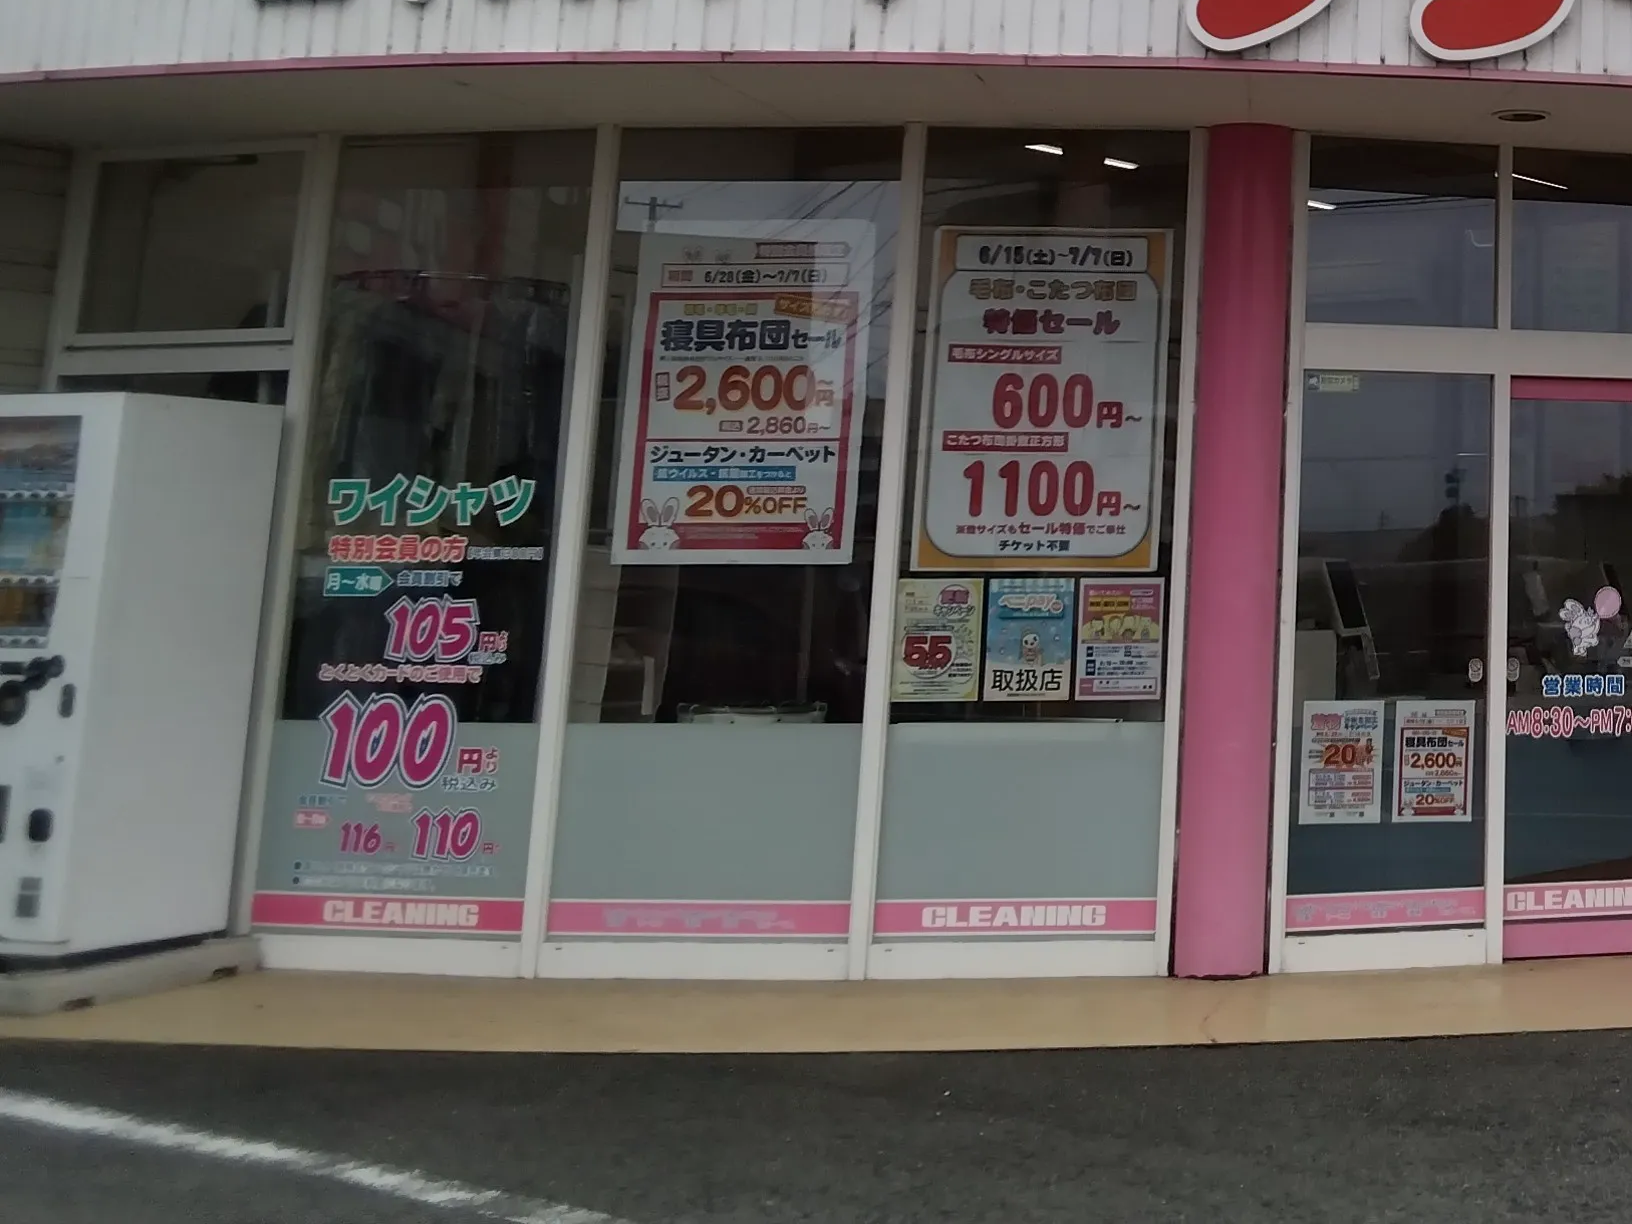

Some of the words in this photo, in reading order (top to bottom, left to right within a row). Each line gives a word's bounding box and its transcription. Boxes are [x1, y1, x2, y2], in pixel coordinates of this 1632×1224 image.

[660, 319, 842, 351] 寝具布団セール
[950, 347, 1059, 362] 毛布シングルサイズ
[328, 473, 536, 526] ワイシャツ
[684, 484, 808, 518] 20%OFF
[328, 533, 468, 563] 特別会員の方
[990, 668, 1064, 693] 取扱店
[1541, 673, 1626, 697] 営業時間
[440, 776, 498, 791] 税込み
[322, 900, 480, 926] CLEANING
[921, 905, 1107, 929] CLEANING
